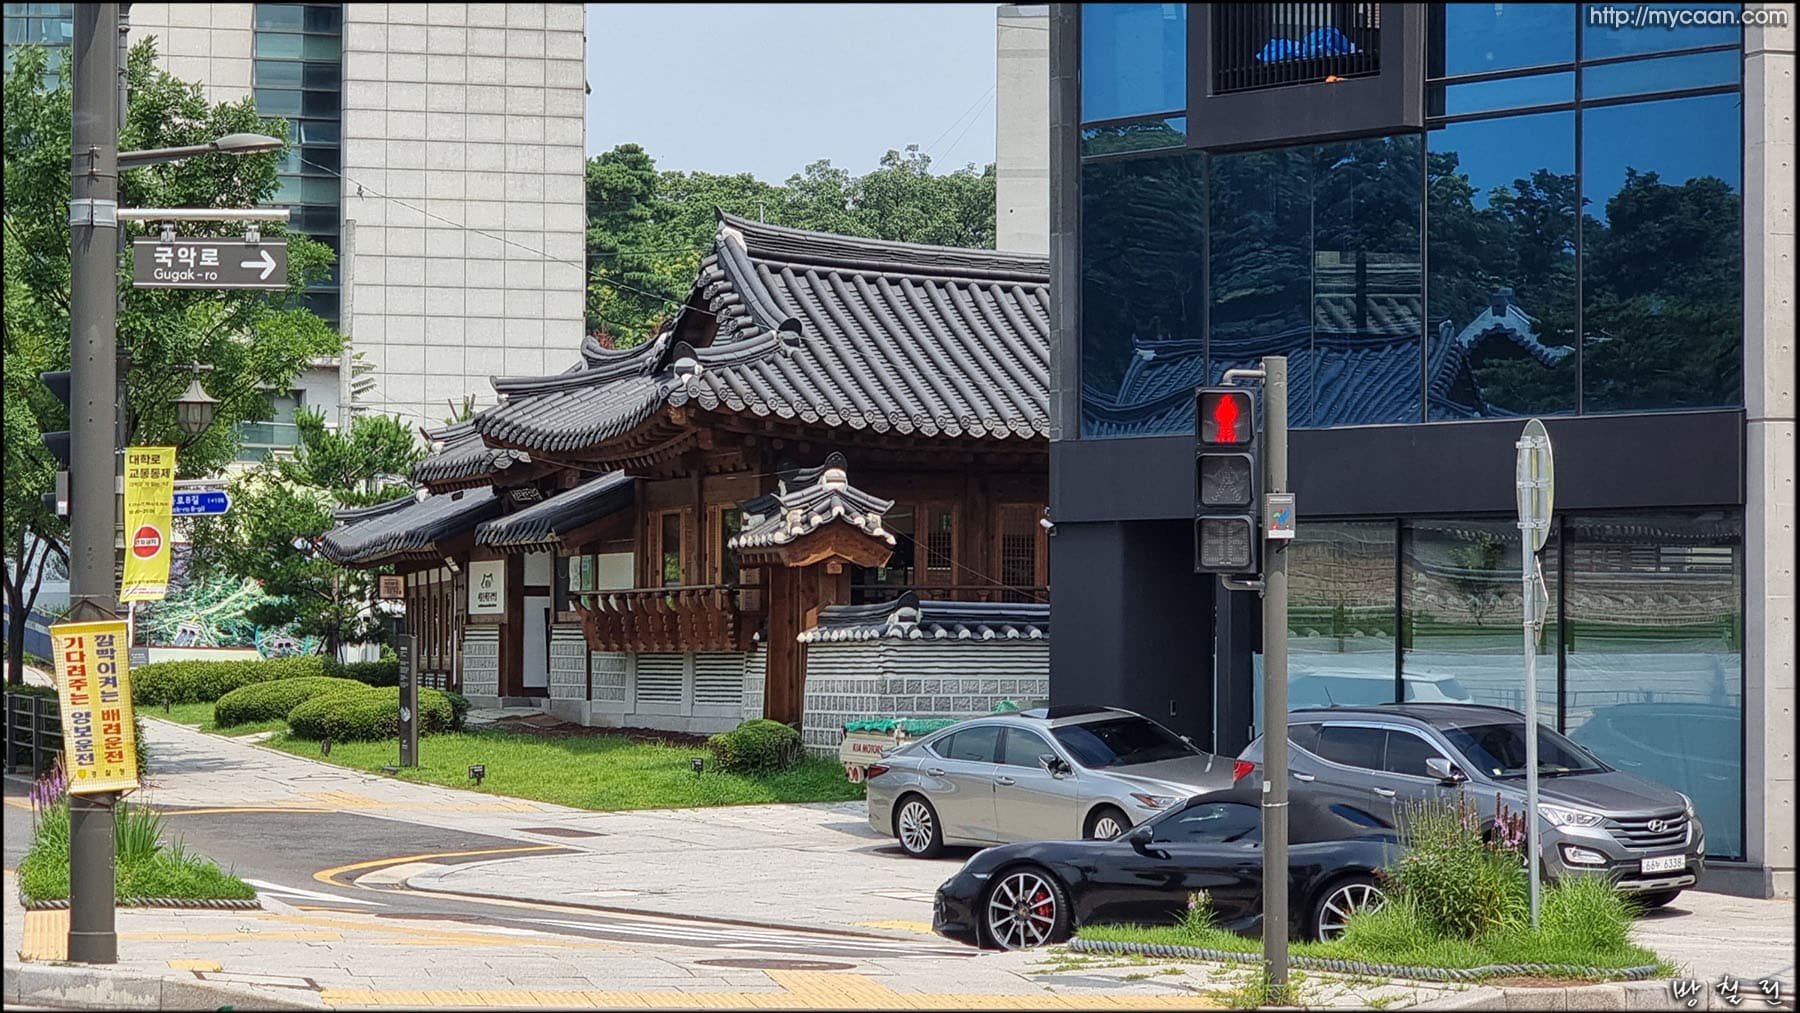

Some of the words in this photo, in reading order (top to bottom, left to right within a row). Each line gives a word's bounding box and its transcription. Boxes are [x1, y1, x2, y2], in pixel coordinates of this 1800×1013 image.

[154, 247, 220, 267] 국악로
[129, 454, 161, 465] 대학로
[64, 636, 89, 706] 기다려주는
[95, 634, 119, 703] 깜빡이켜는
[71, 711, 95, 767] 양보운전
[101, 709, 124, 764] 배려운전
[1664, 857, 1682, 869] 6338
